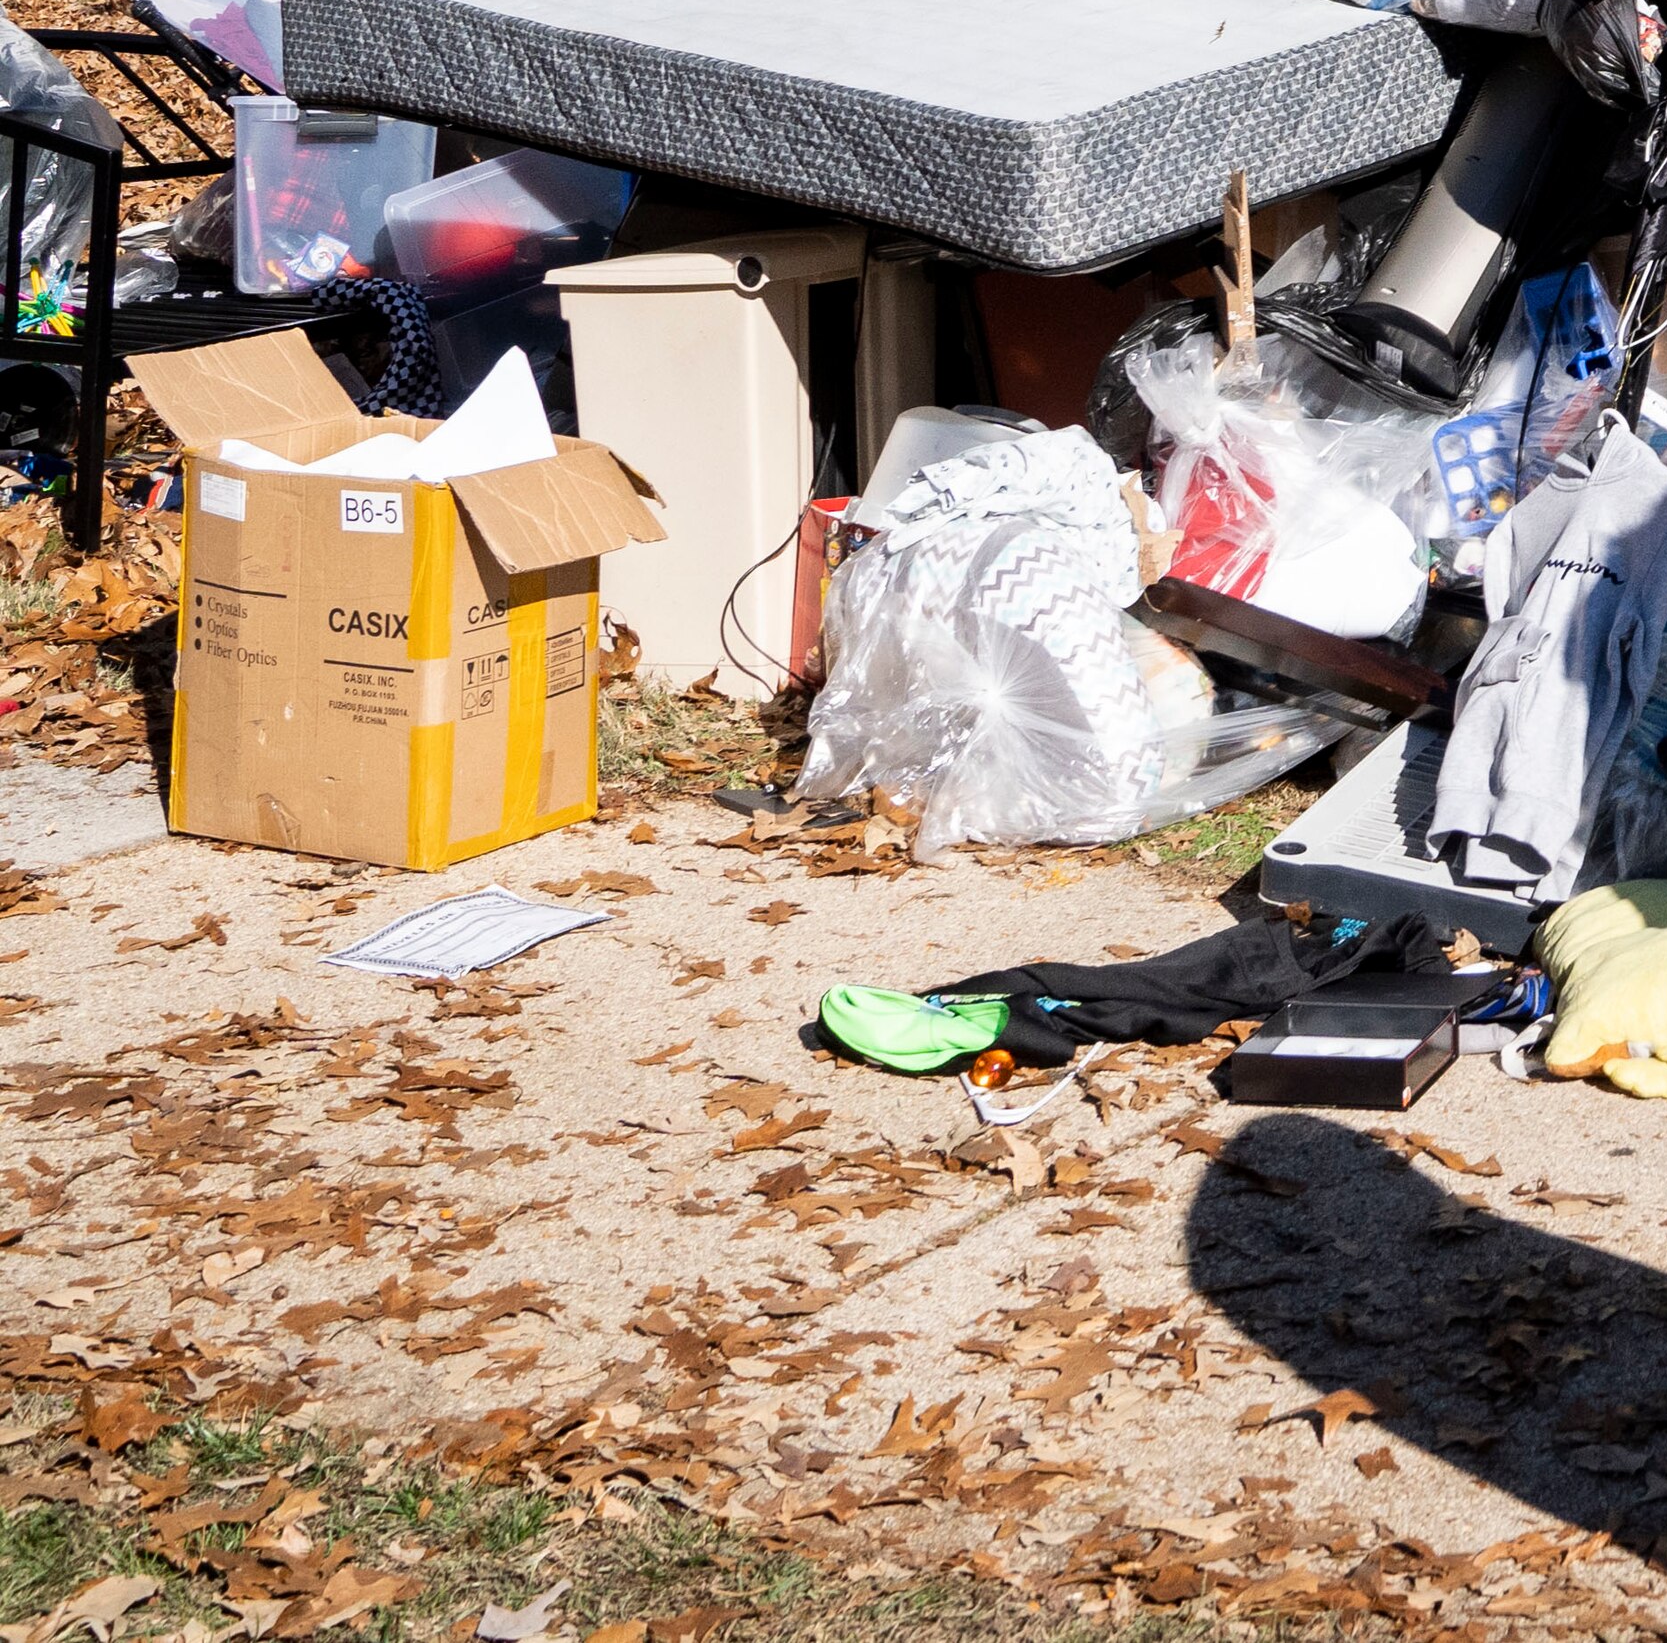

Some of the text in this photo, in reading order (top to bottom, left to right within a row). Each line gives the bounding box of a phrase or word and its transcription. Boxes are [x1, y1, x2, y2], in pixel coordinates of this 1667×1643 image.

[345, 497, 398, 524] B6-5
[1545, 557, 1625, 586] mpion
[207, 595, 249, 619] Crystals
[207, 618, 239, 640] Optics
[328, 607, 410, 641] CASIX
[206, 638, 278, 667] Fiber Optics
